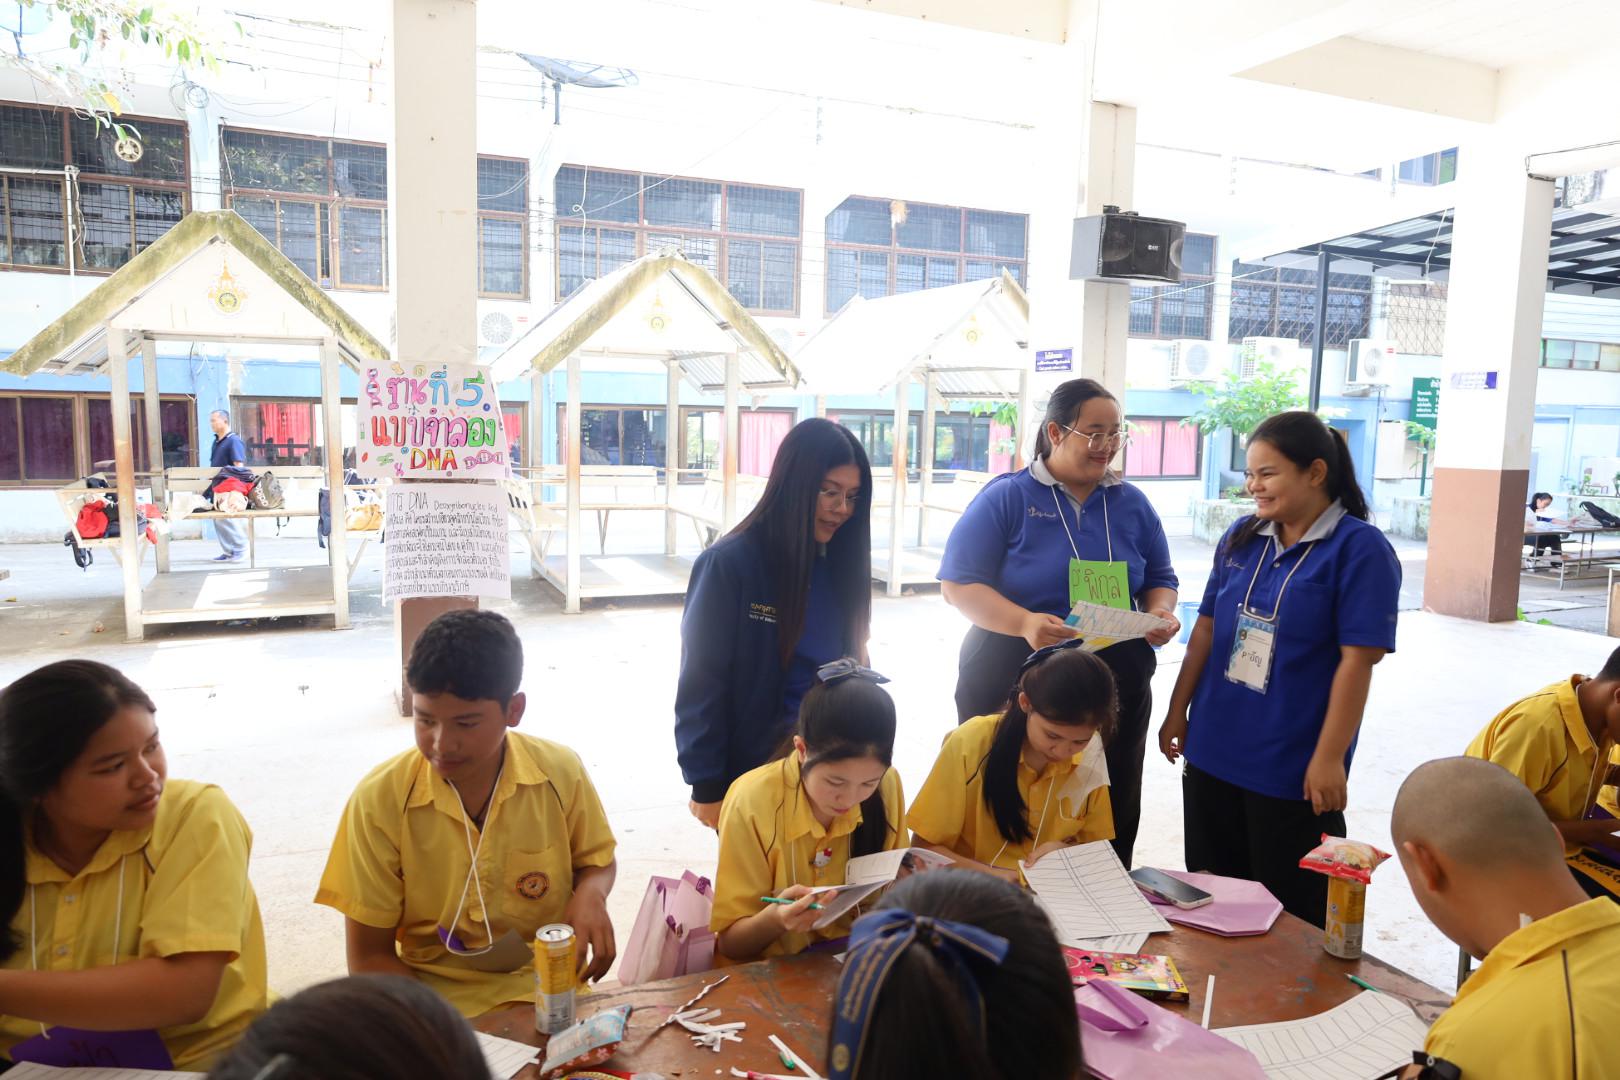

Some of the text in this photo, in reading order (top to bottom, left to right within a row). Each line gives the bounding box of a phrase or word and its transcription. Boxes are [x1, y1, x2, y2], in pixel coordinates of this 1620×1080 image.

[386, 364, 485, 410] ฐานที่ 5
[371, 408, 496, 448] แบบจำลอง
[410, 448, 458, 471] DNA
[409, 491, 428, 510] DNA
